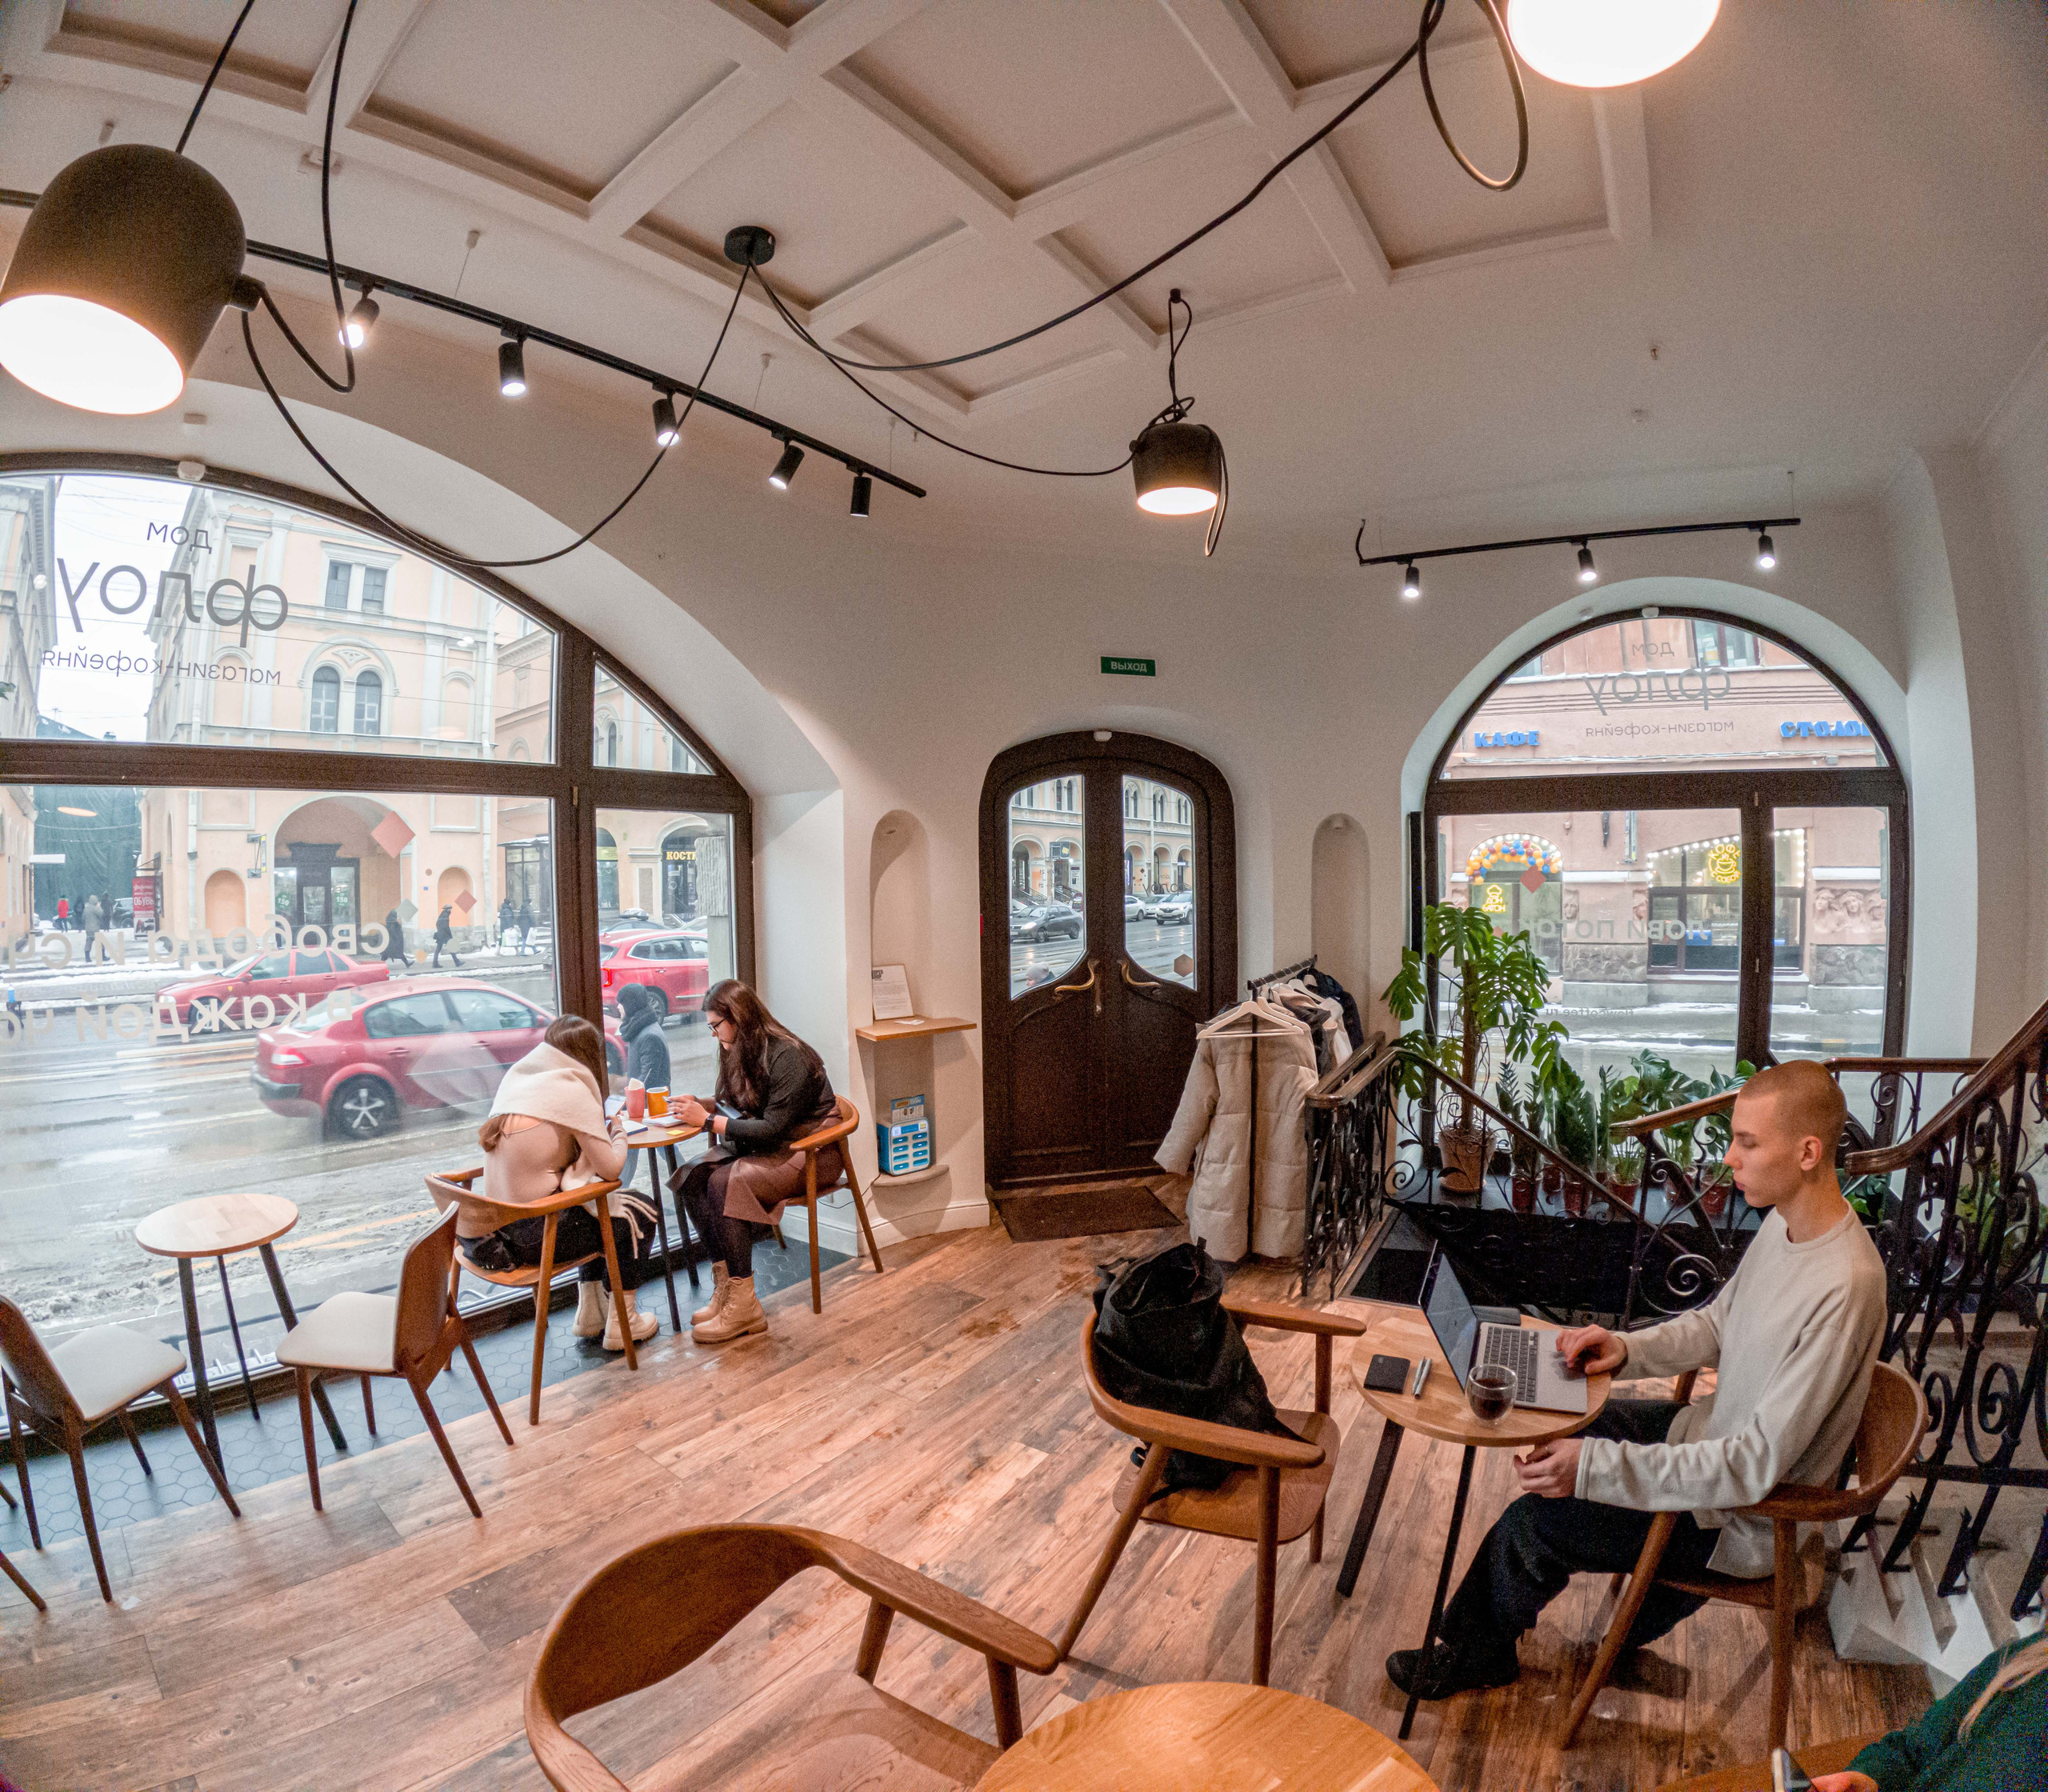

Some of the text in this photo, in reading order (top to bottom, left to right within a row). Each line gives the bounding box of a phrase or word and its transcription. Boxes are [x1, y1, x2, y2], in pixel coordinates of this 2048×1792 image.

[1110, 661, 1147, 674] ВЫХОД
[1474, 730, 1541, 746] КАФЕ
[1708, 844, 1741, 860] КОФЕ
[134, 896, 154, 906] ОБУВЬ
[278, 897, 290, 906] 150
[336, 896, 348, 904] 150
